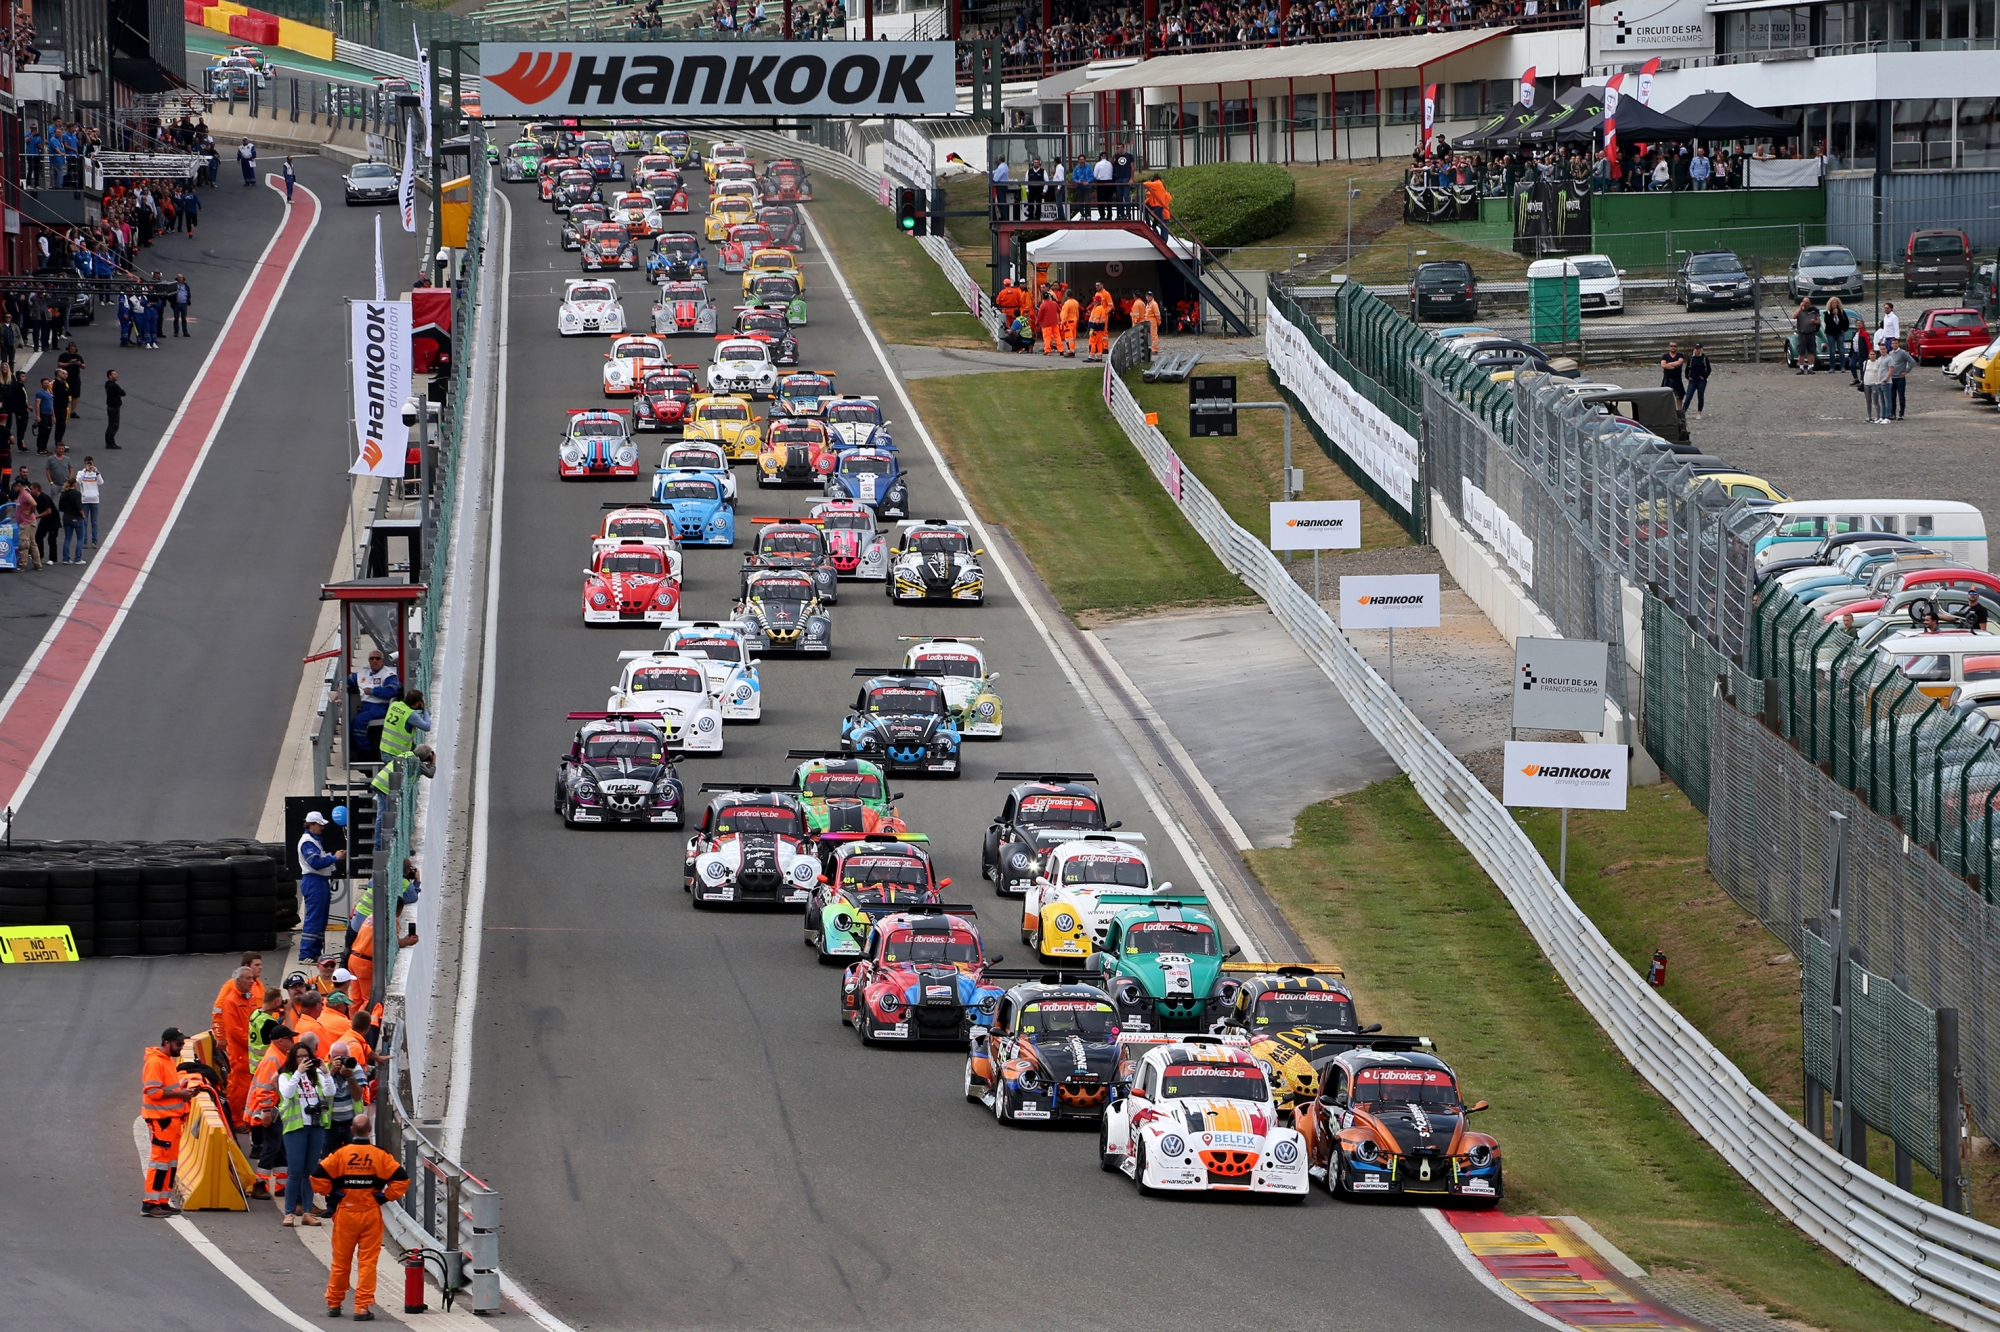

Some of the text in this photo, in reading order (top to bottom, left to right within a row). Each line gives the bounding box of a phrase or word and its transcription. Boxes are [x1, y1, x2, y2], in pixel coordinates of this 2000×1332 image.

[1636, 24, 1703, 36] CIRCUIT DE SPA
[1636, 34, 1703, 44] FRANCORCHAMPS
[1109, 264, 1120, 273] 1C
[387, 306, 402, 409] driving emotion
[825, 511, 861, 519] Ladbrokes.be
[926, 653, 969, 662] Ladbrokes.be
[644, 667, 688, 676] Ladbrokes.be
[1540, 677, 1598, 687] CIRCUIT DE SPA
[882, 687, 926, 696] Ladbrokes.be
[1540, 685, 1598, 694] FRANCORCHAMPS
[386, 713, 400, 726] 22
[1555, 778, 1610, 787] driving emotion
[1034, 797, 1084, 807] Ladbrokes.be
[1077, 854, 1130, 864] Ladbrokes.be
[1066, 874, 1078, 882] 421
[887, 954, 897, 962] 02
[1038, 1002, 1098, 1012] Ladbrokes.be
[1255, 1016, 1269, 1025] 260
[1023, 1025, 1036, 1033] 149
[1181, 1066, 1246, 1078] Ladbrokes.be
[1372, 1070, 1437, 1082] Ladbrokes.be
[1167, 1086, 1178, 1094] 277
[1214, 1133, 1255, 1146] BELFIX
